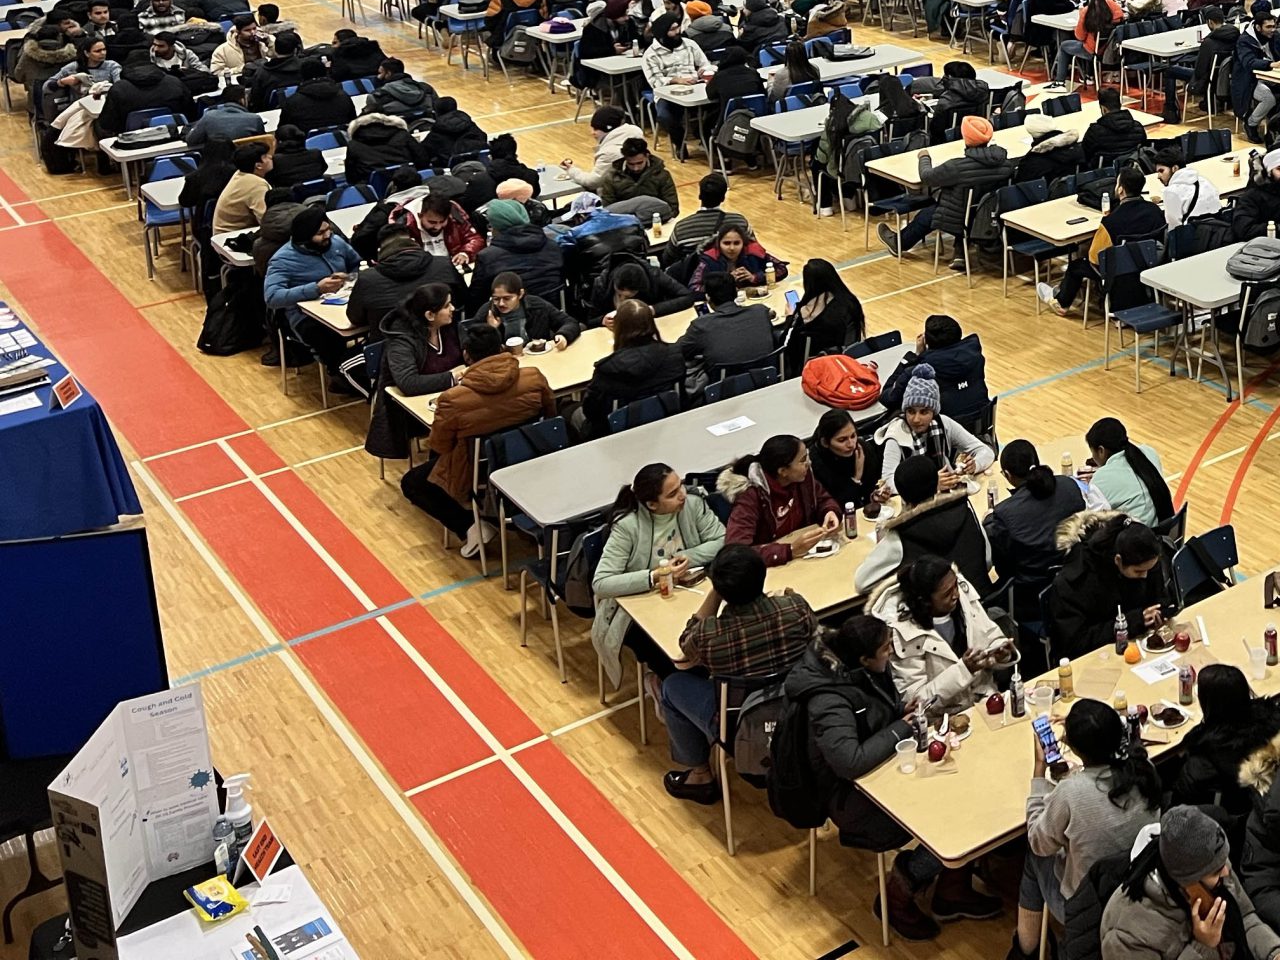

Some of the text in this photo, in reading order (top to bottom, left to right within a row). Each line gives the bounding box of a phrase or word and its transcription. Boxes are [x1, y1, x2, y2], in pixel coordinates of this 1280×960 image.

[131, 692, 192, 714] Cough and Cold
[150, 706, 178, 717] Season
